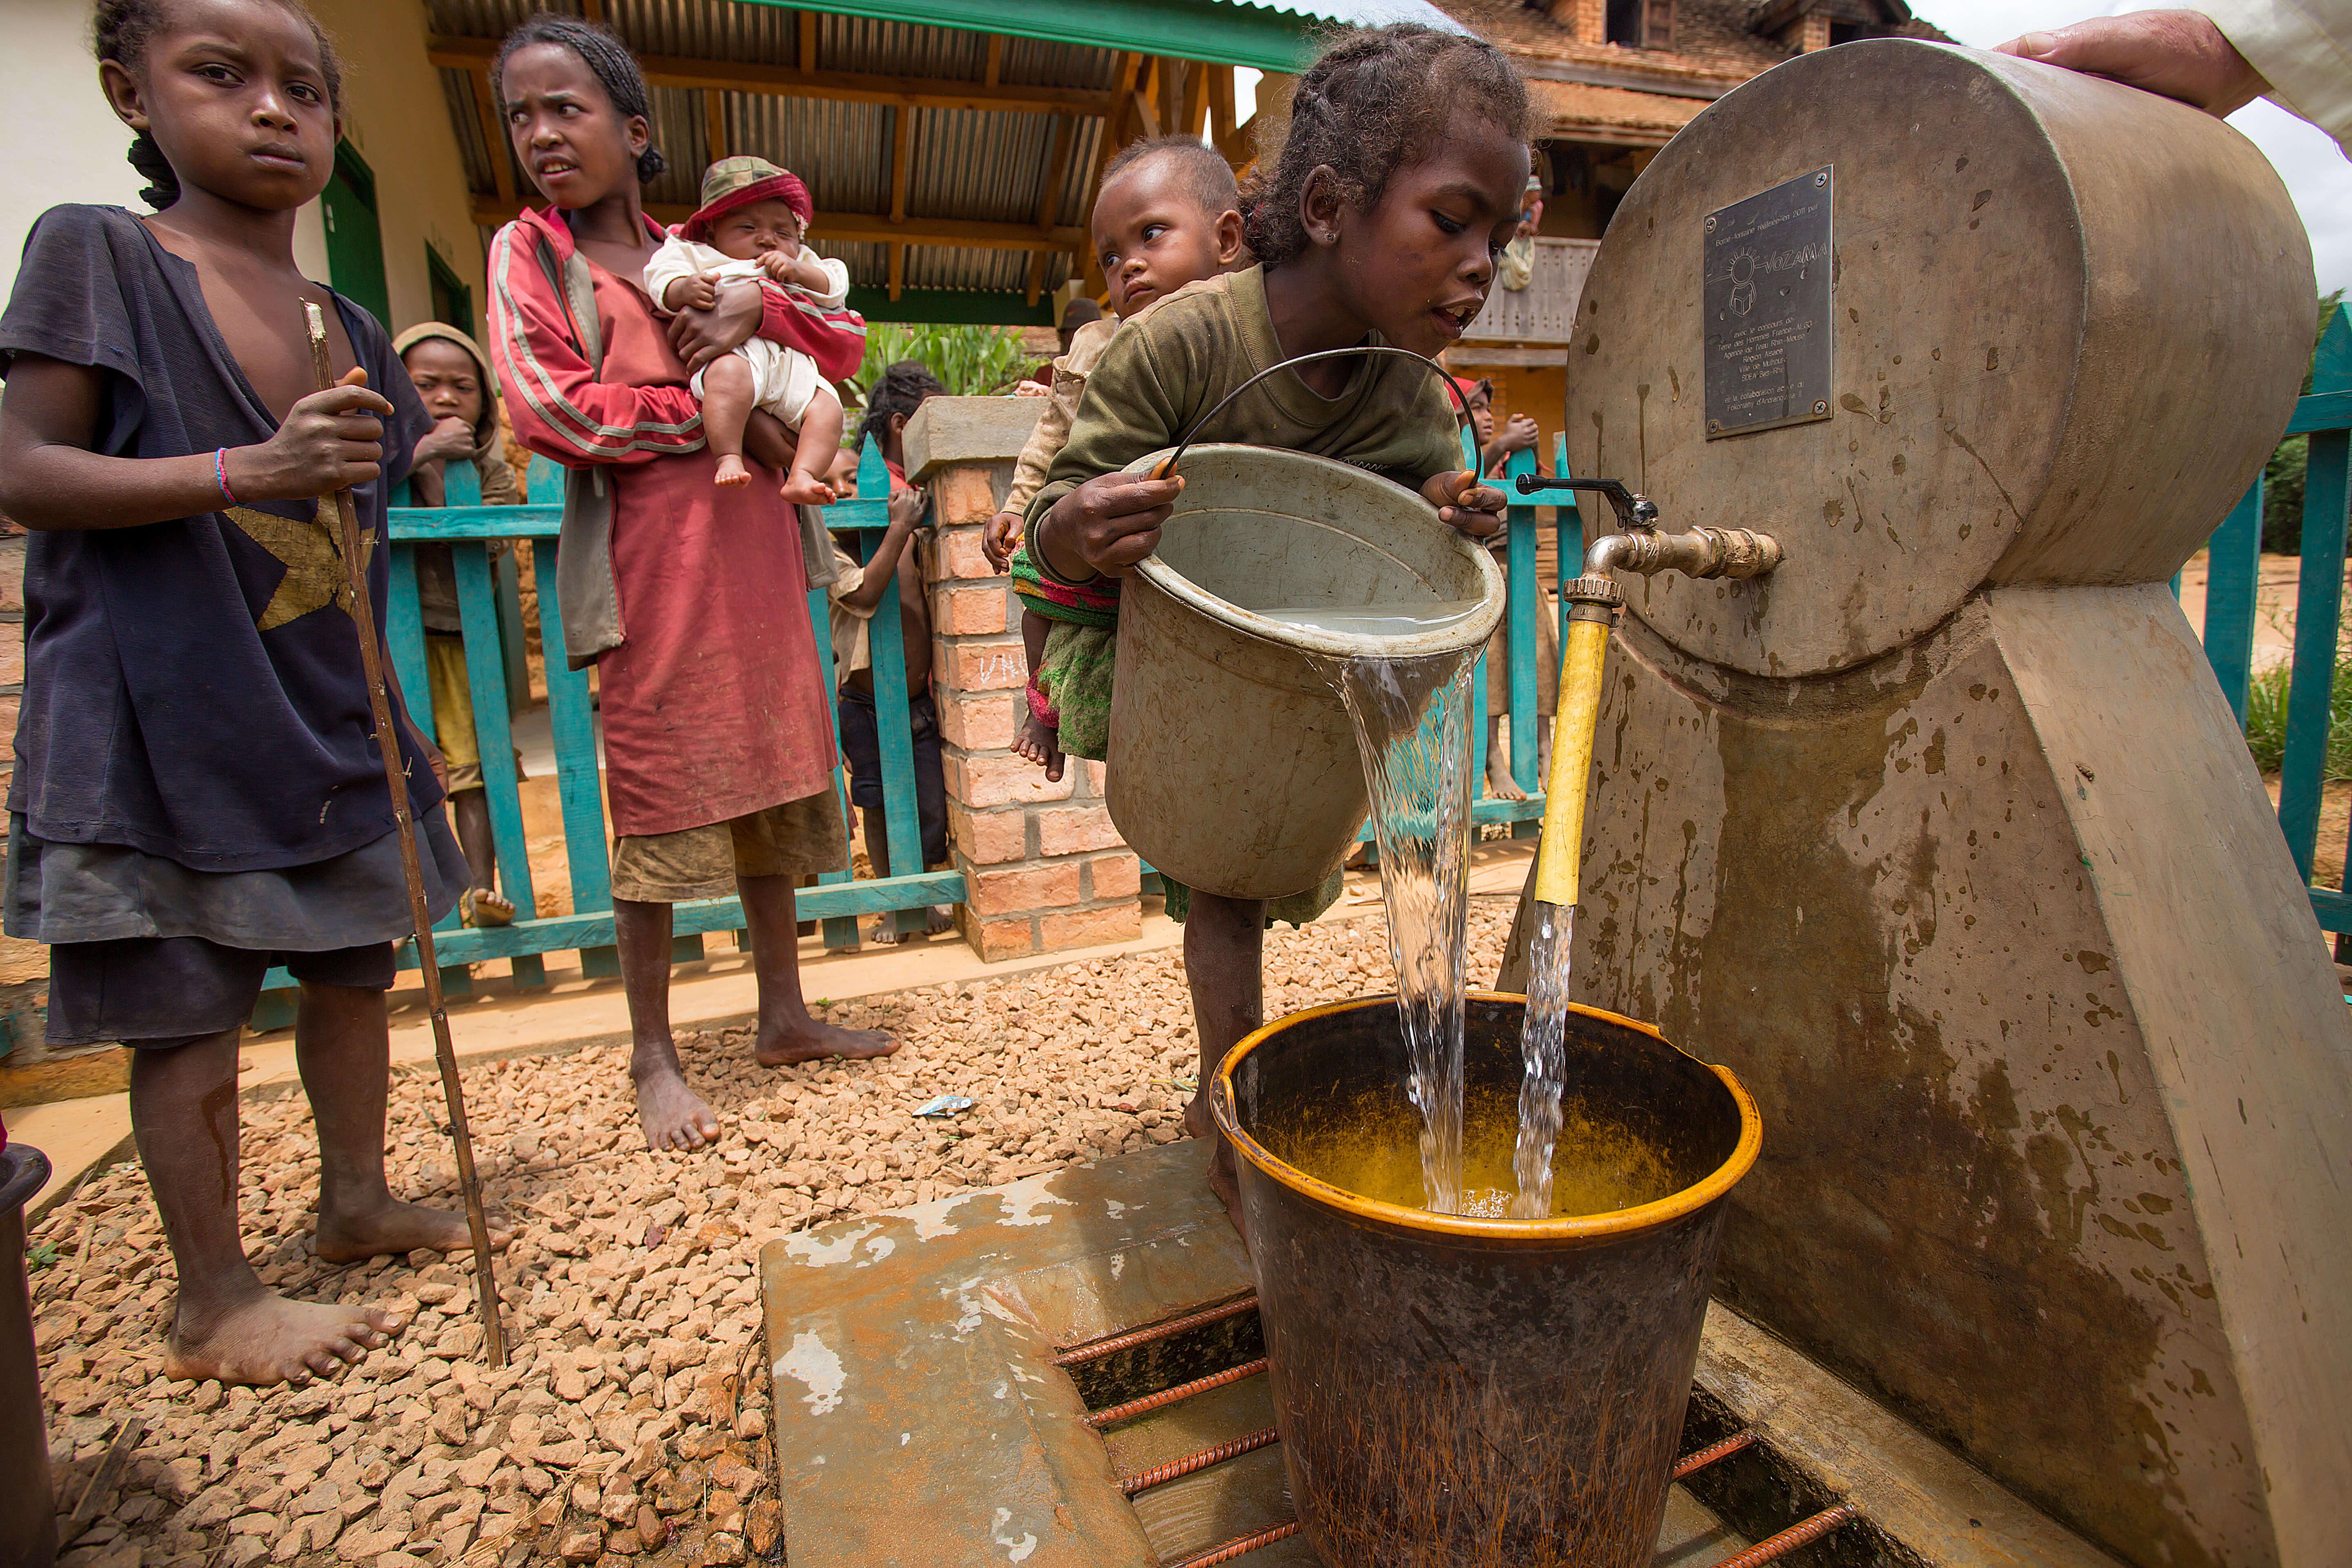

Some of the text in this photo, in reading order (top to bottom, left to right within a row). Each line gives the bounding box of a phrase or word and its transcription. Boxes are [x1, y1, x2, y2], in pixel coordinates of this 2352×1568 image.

[1793, 207, 1805, 218] 2011
[1808, 204, 1817, 213] par
[1734, 330, 1747, 338] avec
[1758, 320, 1783, 332] concours
[1746, 333, 1769, 343] Hommes
[1724, 349, 1743, 359] Agence
[1771, 334, 1805, 346] Rhin-Meuse
[1743, 348, 1783, 363] Région Alsace
[1739, 365, 1750, 373] Ville
[1742, 373, 1757, 381] SDEA
[1740, 388, 1774, 400] collaboration
